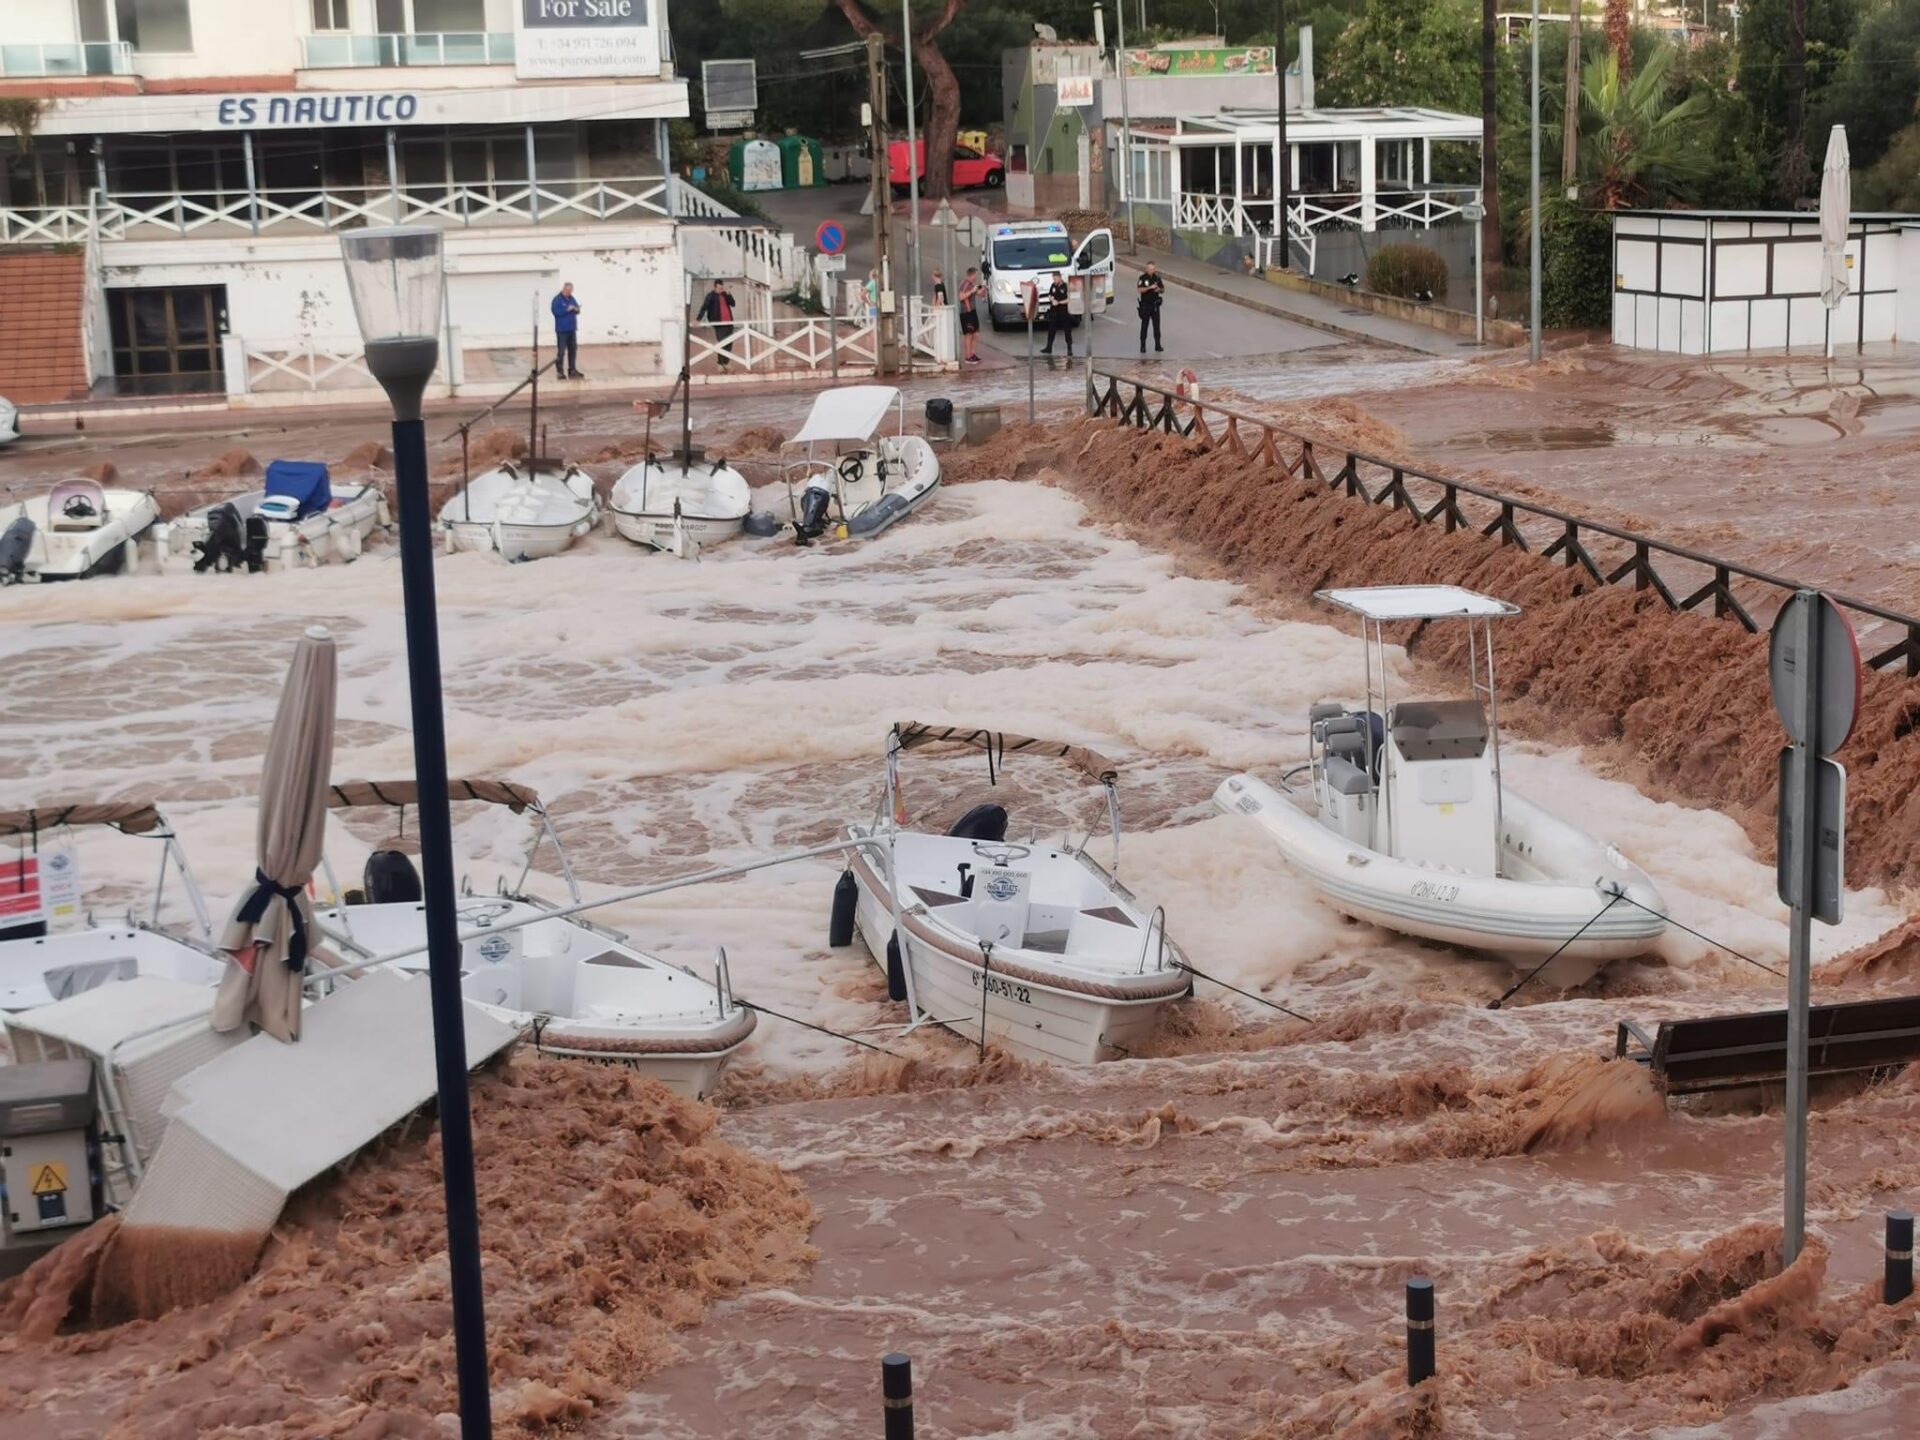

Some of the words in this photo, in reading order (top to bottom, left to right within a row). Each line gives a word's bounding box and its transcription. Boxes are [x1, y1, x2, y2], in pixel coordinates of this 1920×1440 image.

[539, 0, 579, 18] For
[584, 0, 632, 18] Sale
[218, 98, 258, 125] ES
[268, 94, 418, 124] NAUTICO
